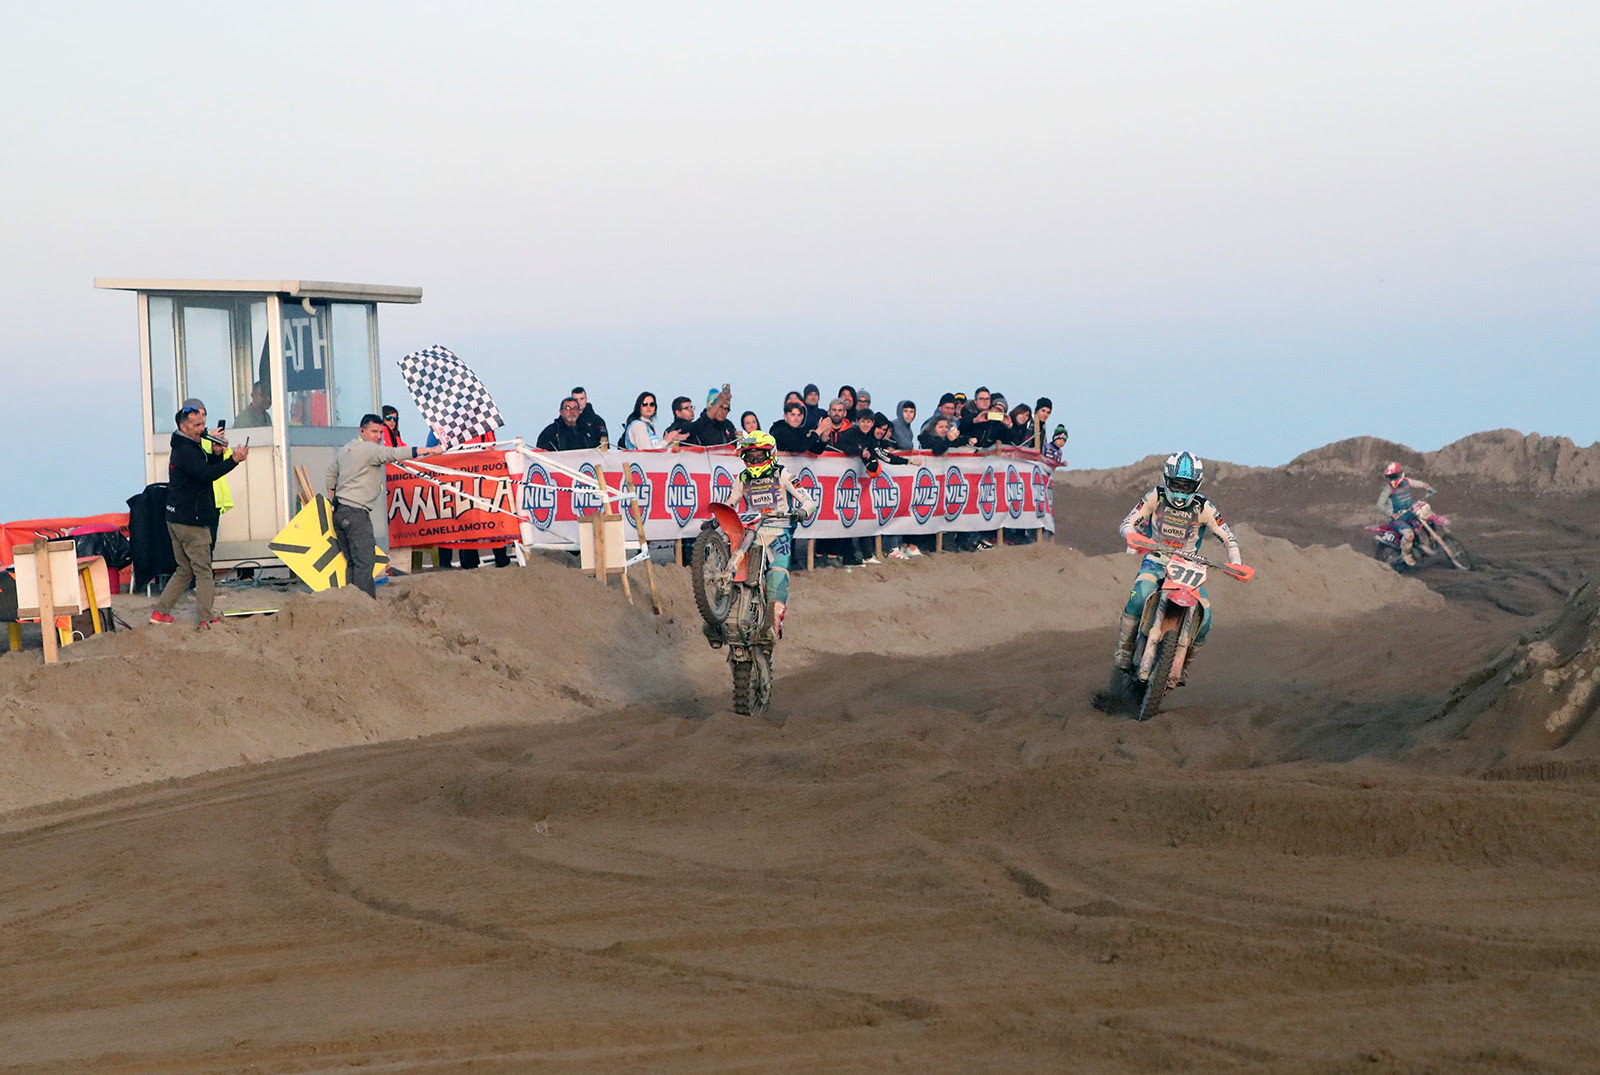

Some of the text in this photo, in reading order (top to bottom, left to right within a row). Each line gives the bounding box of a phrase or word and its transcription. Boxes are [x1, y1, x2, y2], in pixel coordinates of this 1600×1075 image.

[482, 461, 508, 472] RUOT
[386, 476, 517, 525] ANELLA
[523, 485, 555, 509] NILS
[668, 485, 695, 507] NILS
[836, 487, 860, 509] NILS
[872, 487, 899, 508] NILS
[912, 486, 938, 506] NILS
[945, 484, 968, 504] NILS
[979, 483, 996, 503] NILS
[1007, 482, 1023, 501] NILS
[1164, 506, 1192, 518] FORN
[1170, 564, 1204, 587] 311
